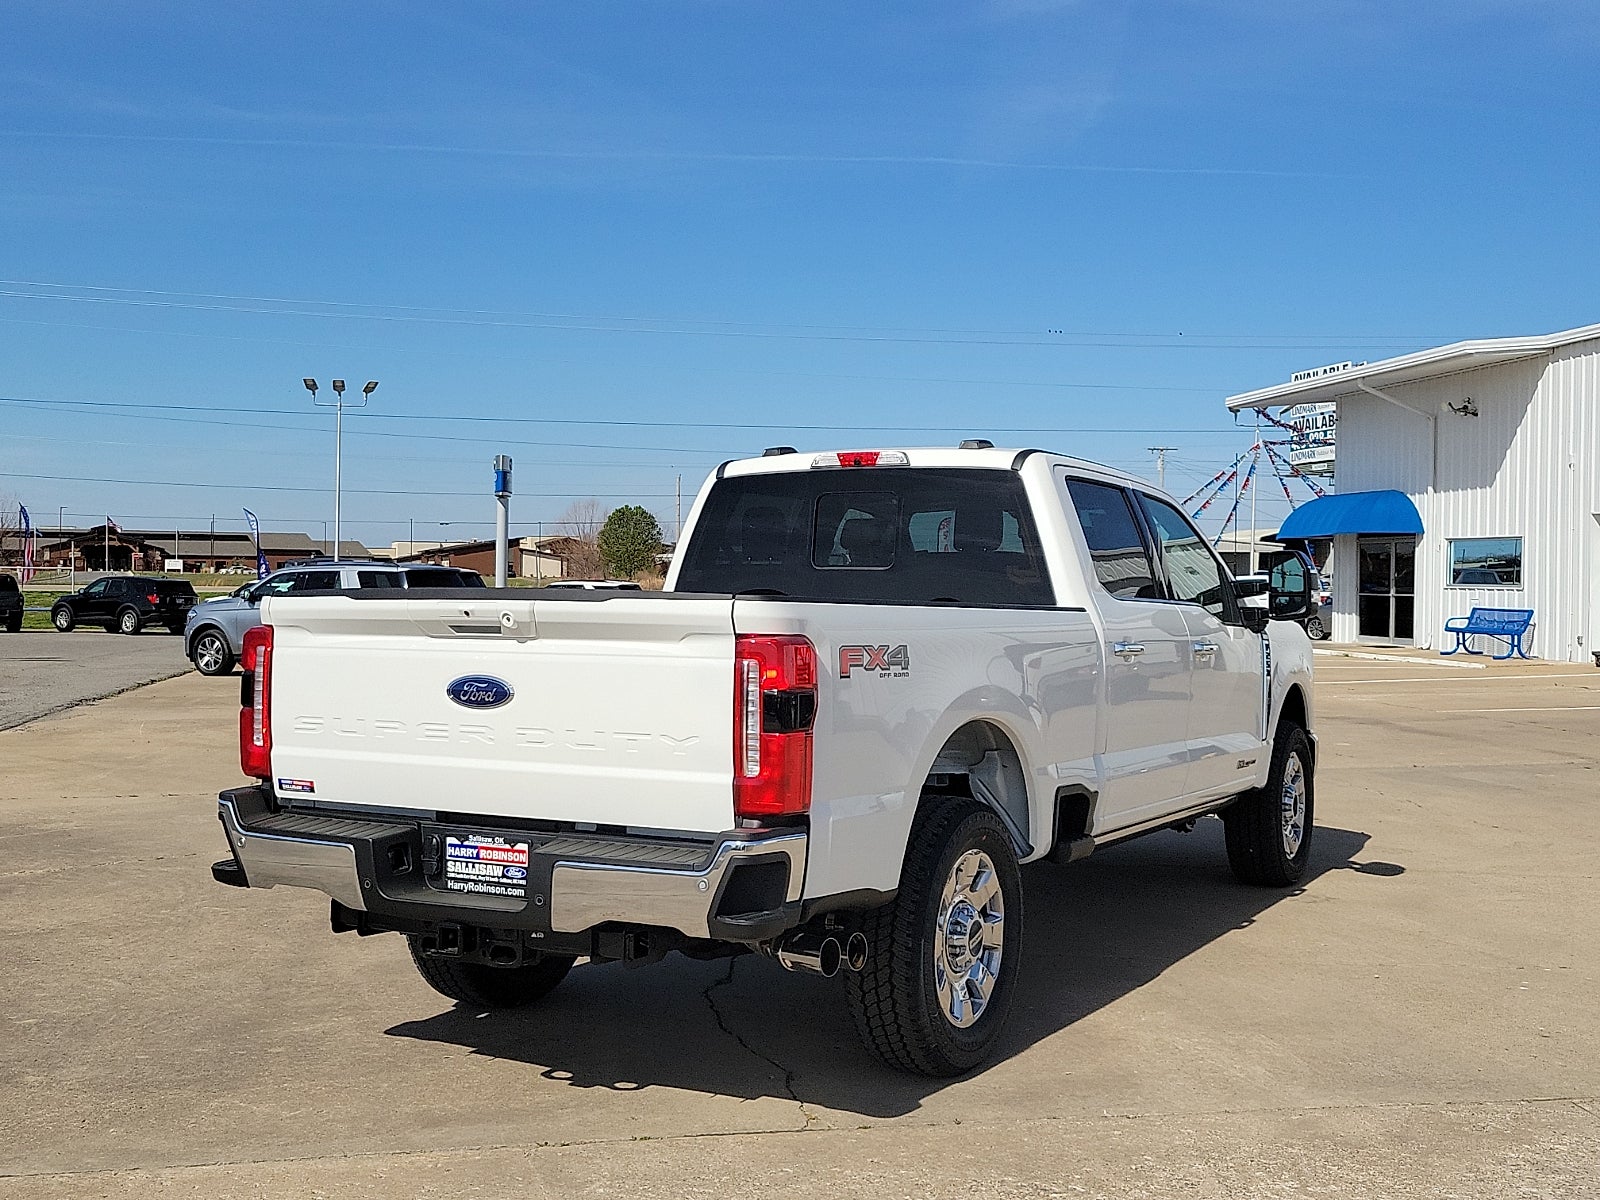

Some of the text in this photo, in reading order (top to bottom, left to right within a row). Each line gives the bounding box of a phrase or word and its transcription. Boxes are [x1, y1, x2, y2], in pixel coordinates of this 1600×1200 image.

[839, 645, 909, 679] FX4
[460, 681, 498, 702] Ford
[294, 715, 700, 755] SUPER DUTY
[494, 836, 505, 844] OK
[448, 846, 527, 863] HARRY ROBINSON
[447, 861, 504, 877] SALLISAW
[447, 880, 525, 897] HarryRobinson.com
